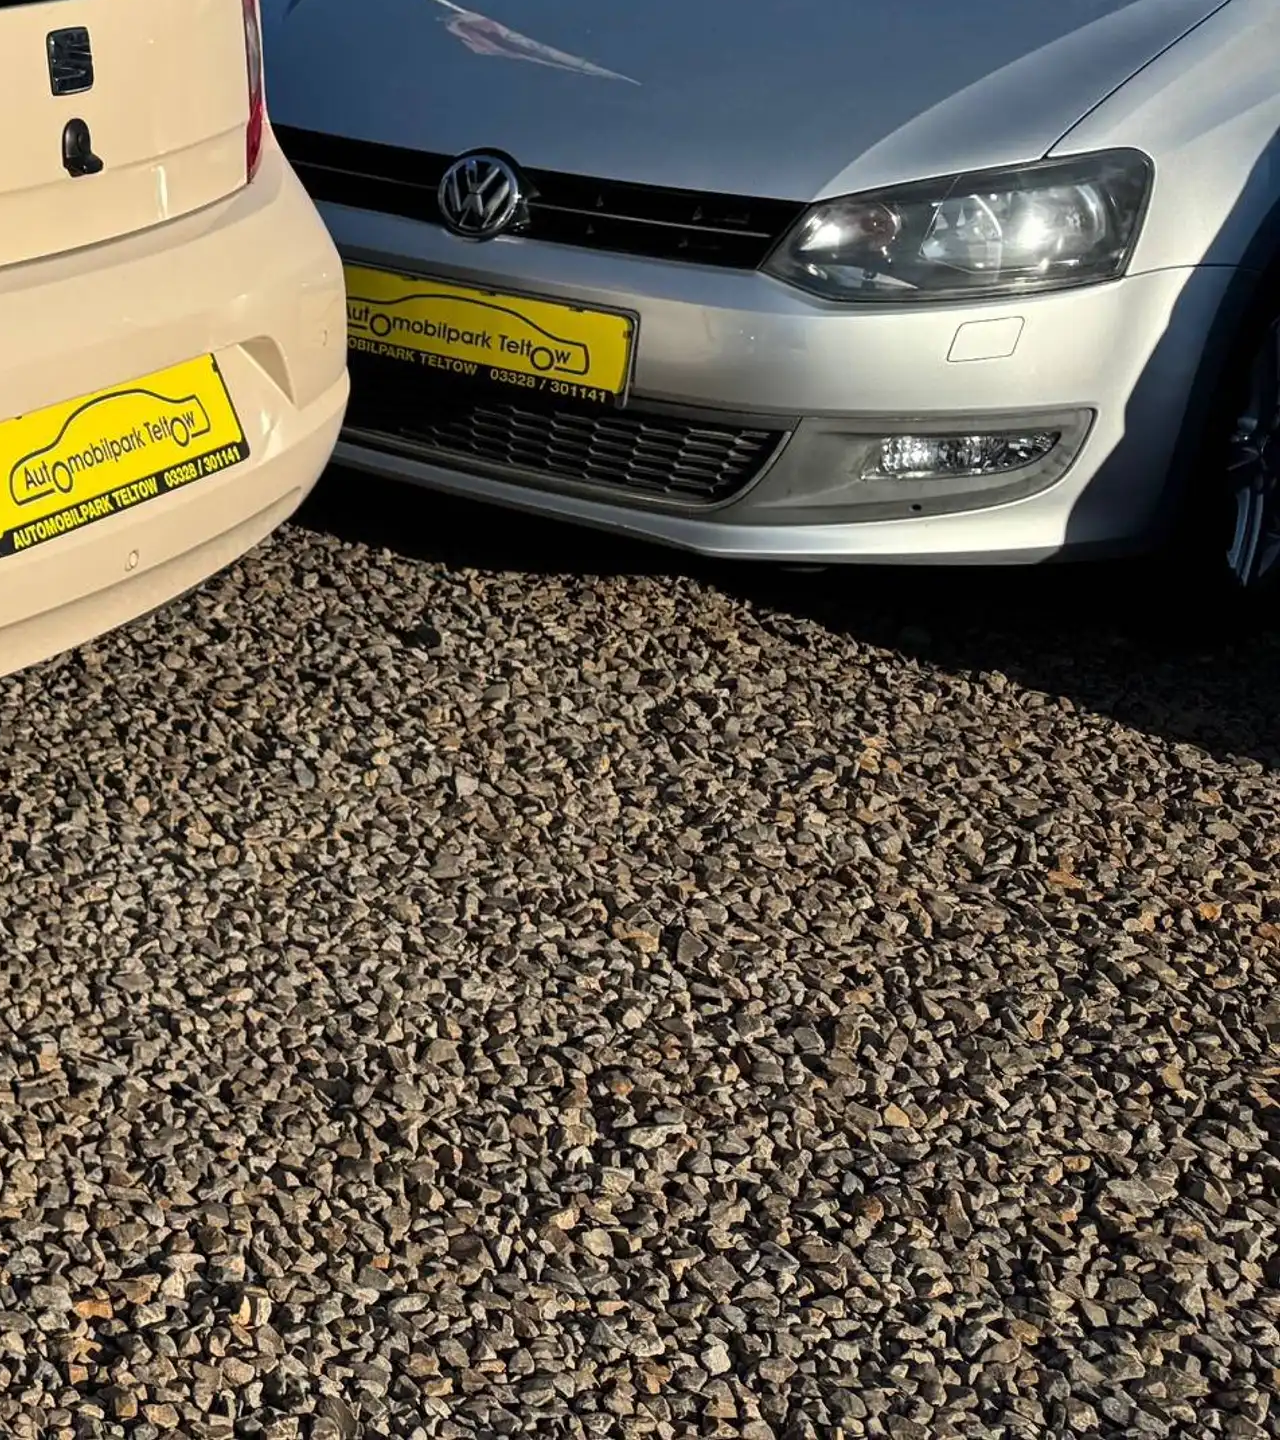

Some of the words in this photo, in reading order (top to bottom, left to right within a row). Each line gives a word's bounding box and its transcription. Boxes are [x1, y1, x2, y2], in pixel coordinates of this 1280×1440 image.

[346, 333, 415, 363] OBILPARK
[419, 352, 478, 376] TELTOW
[489, 367, 536, 389] 03328
[549, 379, 606, 404] 301141
[12, 495, 114, 550] AUTOMOBILPARK
[111, 476, 160, 509] TELTOW
[163, 463, 197, 488] 03328
[203, 446, 242, 472] 301141
